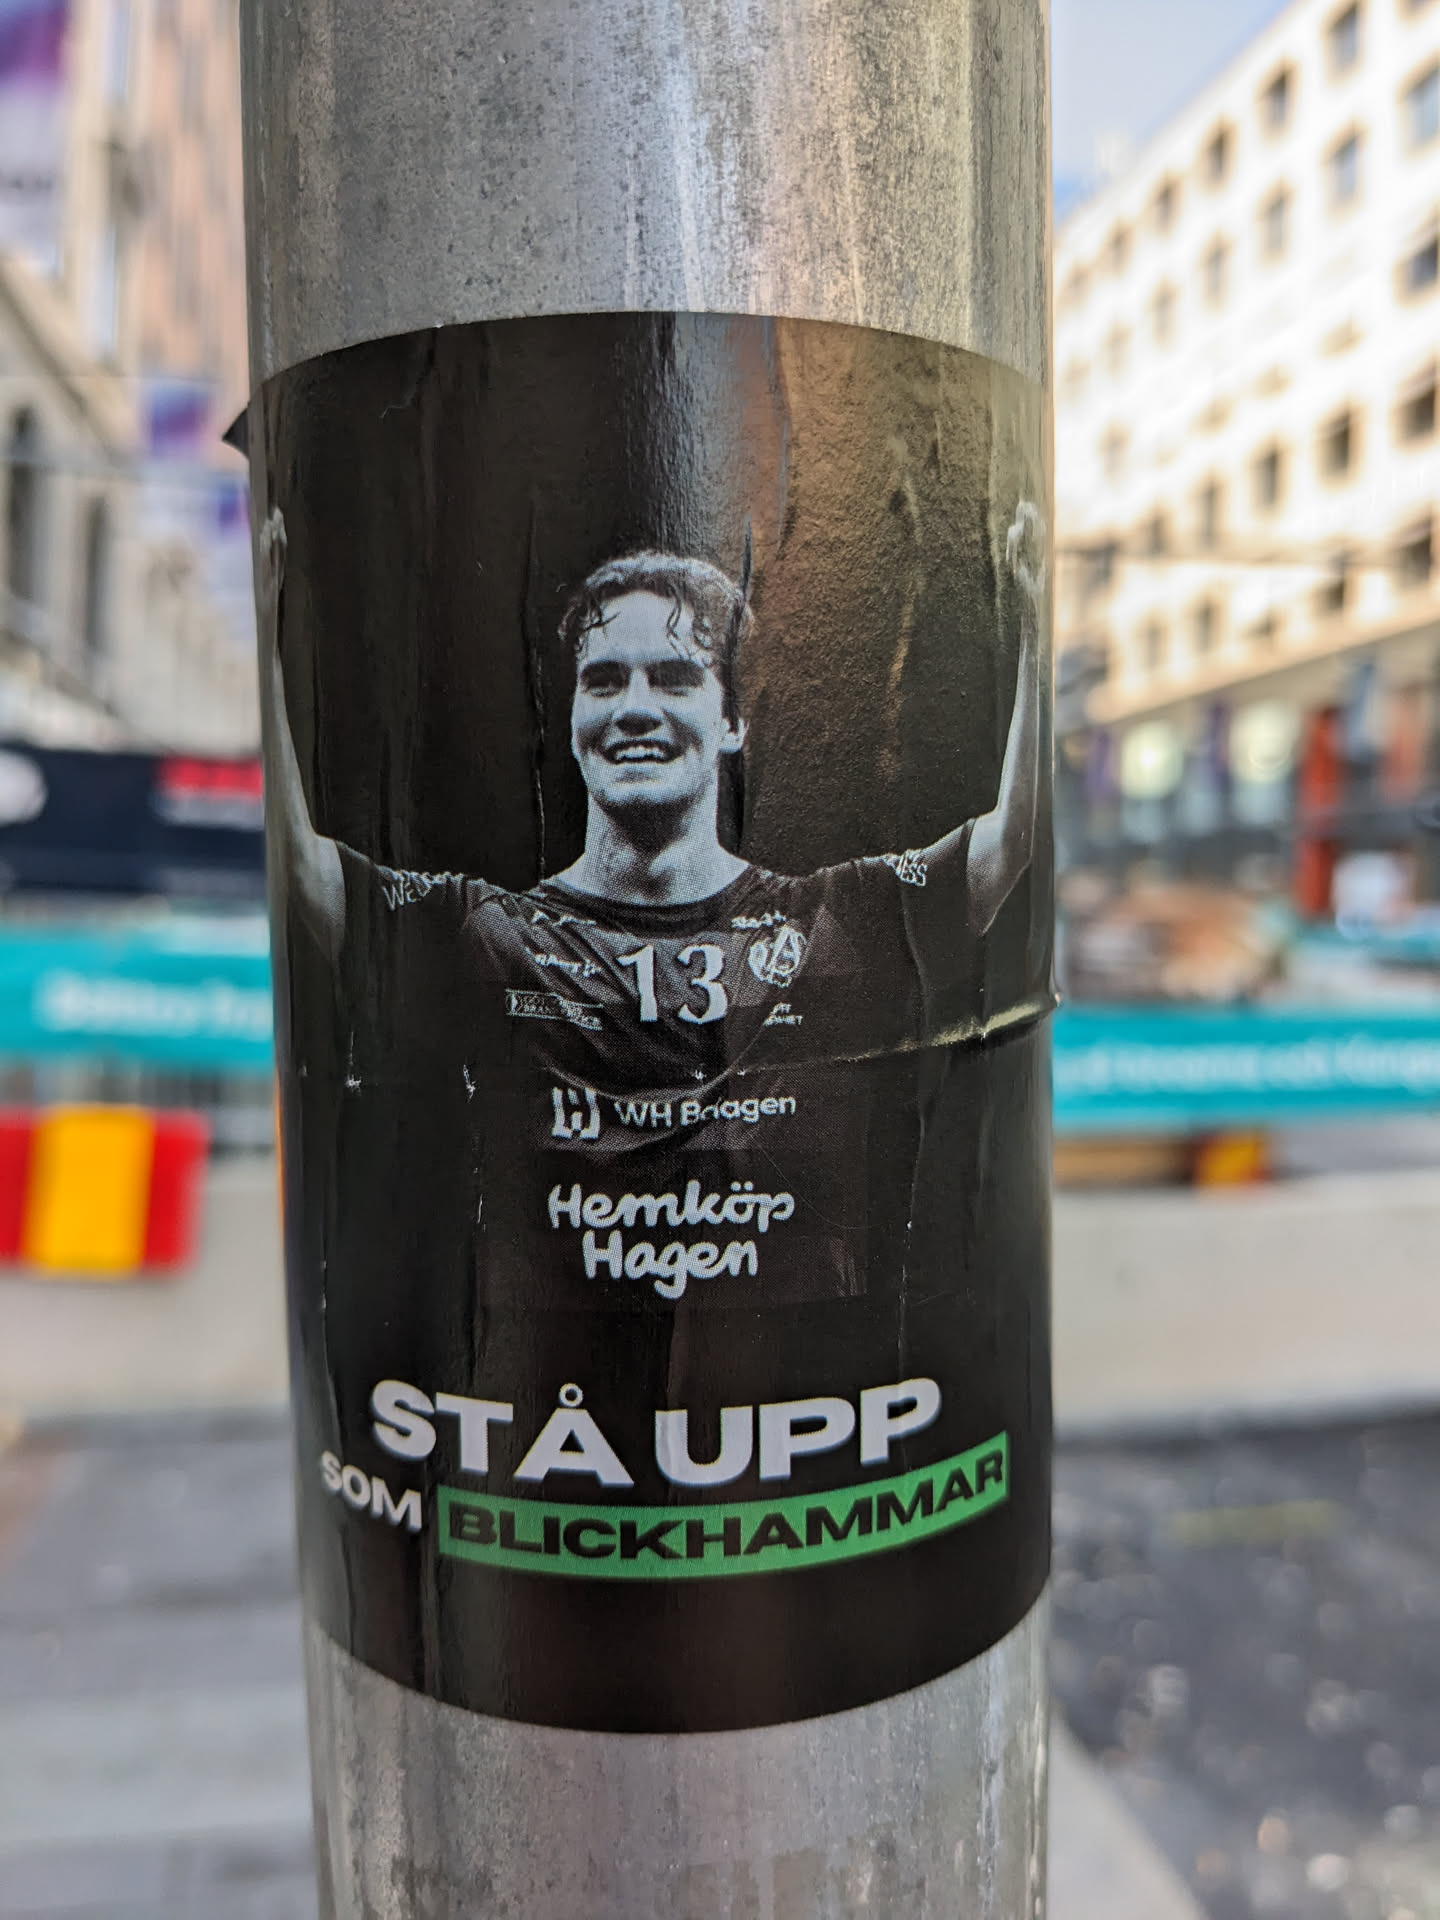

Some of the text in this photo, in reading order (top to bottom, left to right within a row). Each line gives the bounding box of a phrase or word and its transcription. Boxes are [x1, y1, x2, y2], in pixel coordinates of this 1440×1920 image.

[617, 944, 728, 1023] 13
[614, 1100, 672, 1127] WH
[548, 1179, 795, 1232] Hemköp
[583, 1230, 758, 1299] Hagen
[371, 1377, 941, 1487] STÅ UPP
[321, 1448, 1004, 1560] SOM BLICKHAMMAR
